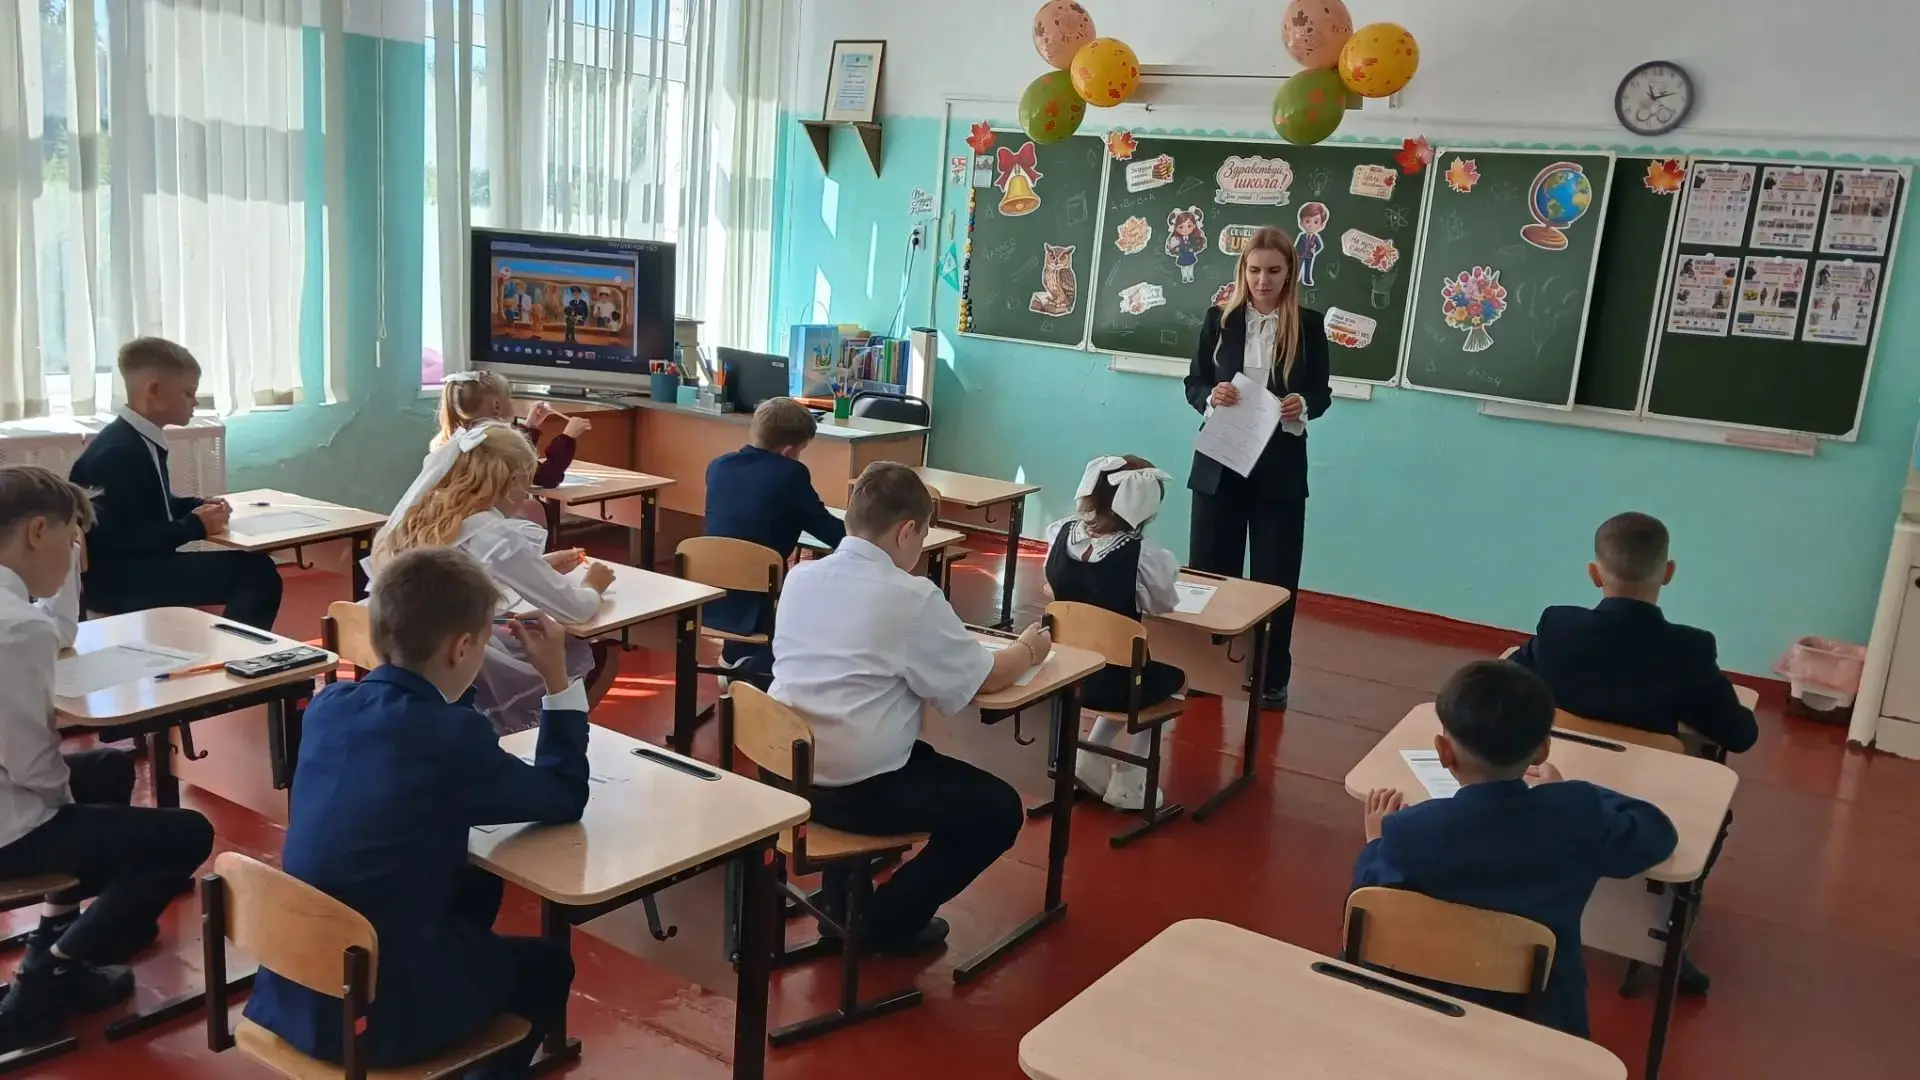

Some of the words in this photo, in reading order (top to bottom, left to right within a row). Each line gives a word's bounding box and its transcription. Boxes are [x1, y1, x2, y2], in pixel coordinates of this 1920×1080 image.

[1223, 161, 1285, 179] Здравствуй,
[1234, 173, 1288, 189] школа!
[1230, 229, 1252, 237] LEVEL
